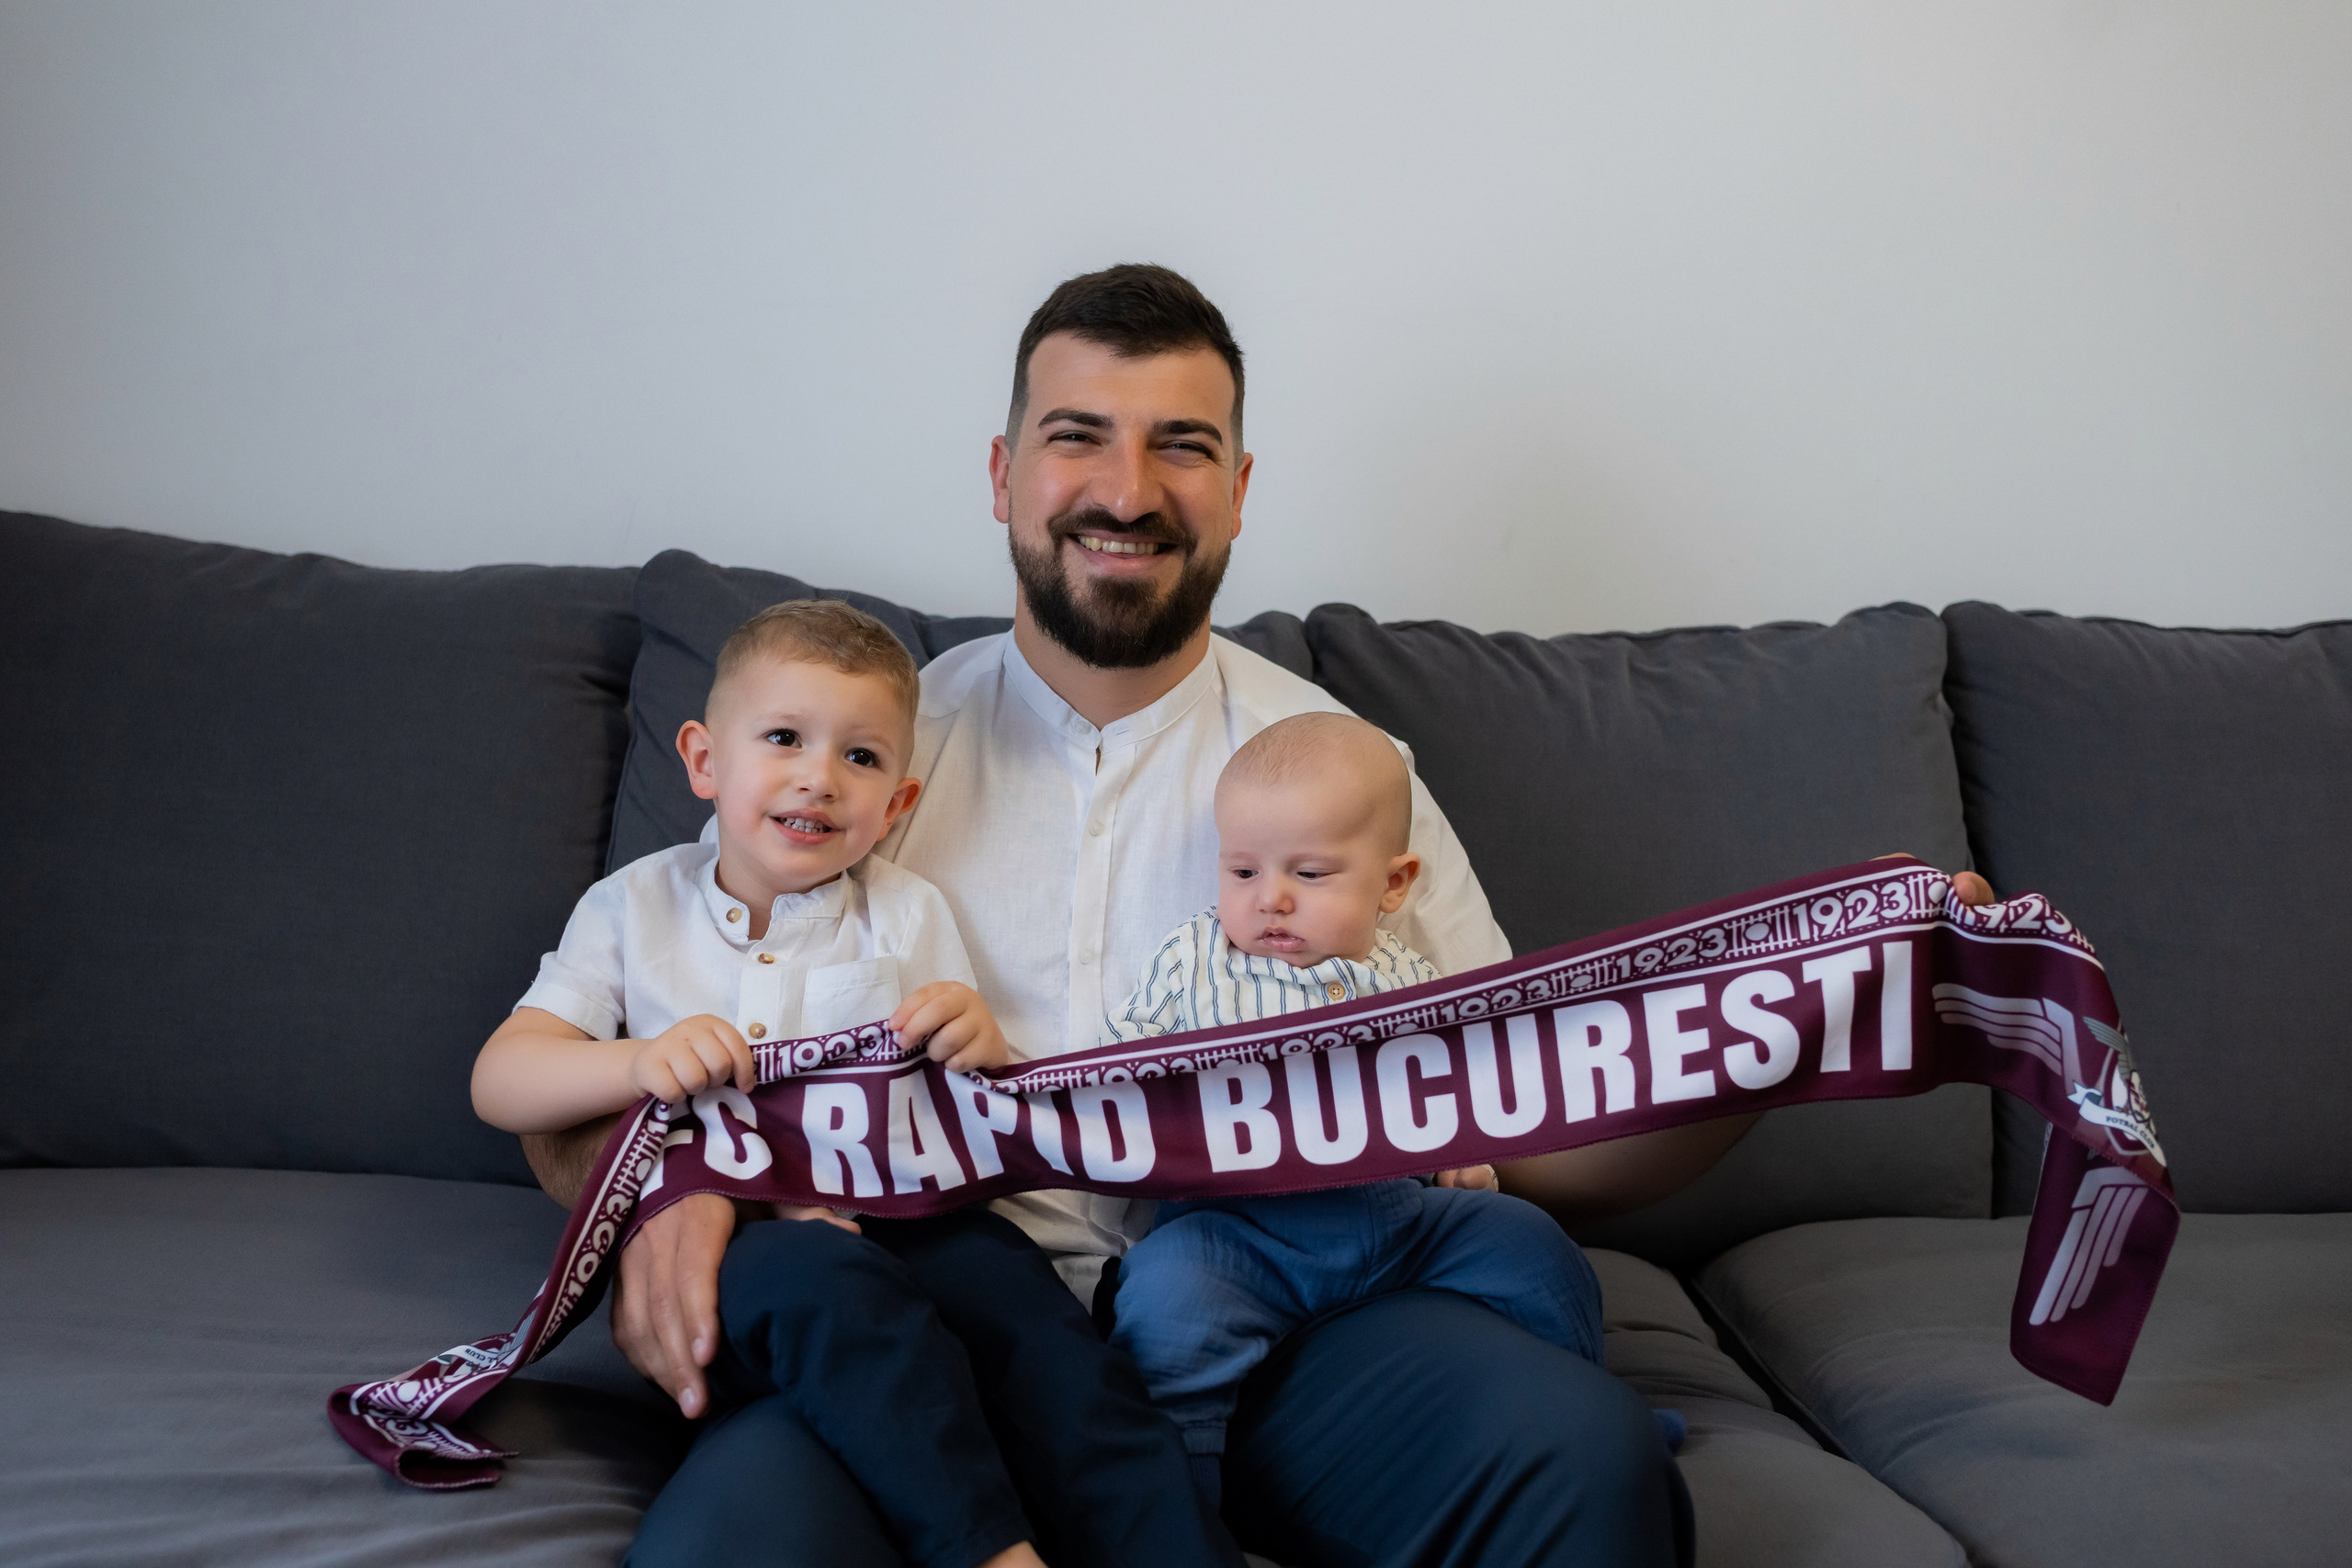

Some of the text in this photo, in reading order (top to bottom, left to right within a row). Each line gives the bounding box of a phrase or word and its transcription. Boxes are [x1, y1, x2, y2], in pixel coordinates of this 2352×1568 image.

[779, 1025, 885, 1078] 1923
[1438, 978, 1553, 1023] 1923
[1616, 928, 1727, 979] 1923
[1792, 882, 1910, 942] 1923
[801, 1064, 1158, 1199] RAPID
[1195, 940, 1914, 1174] BUCURESTI
